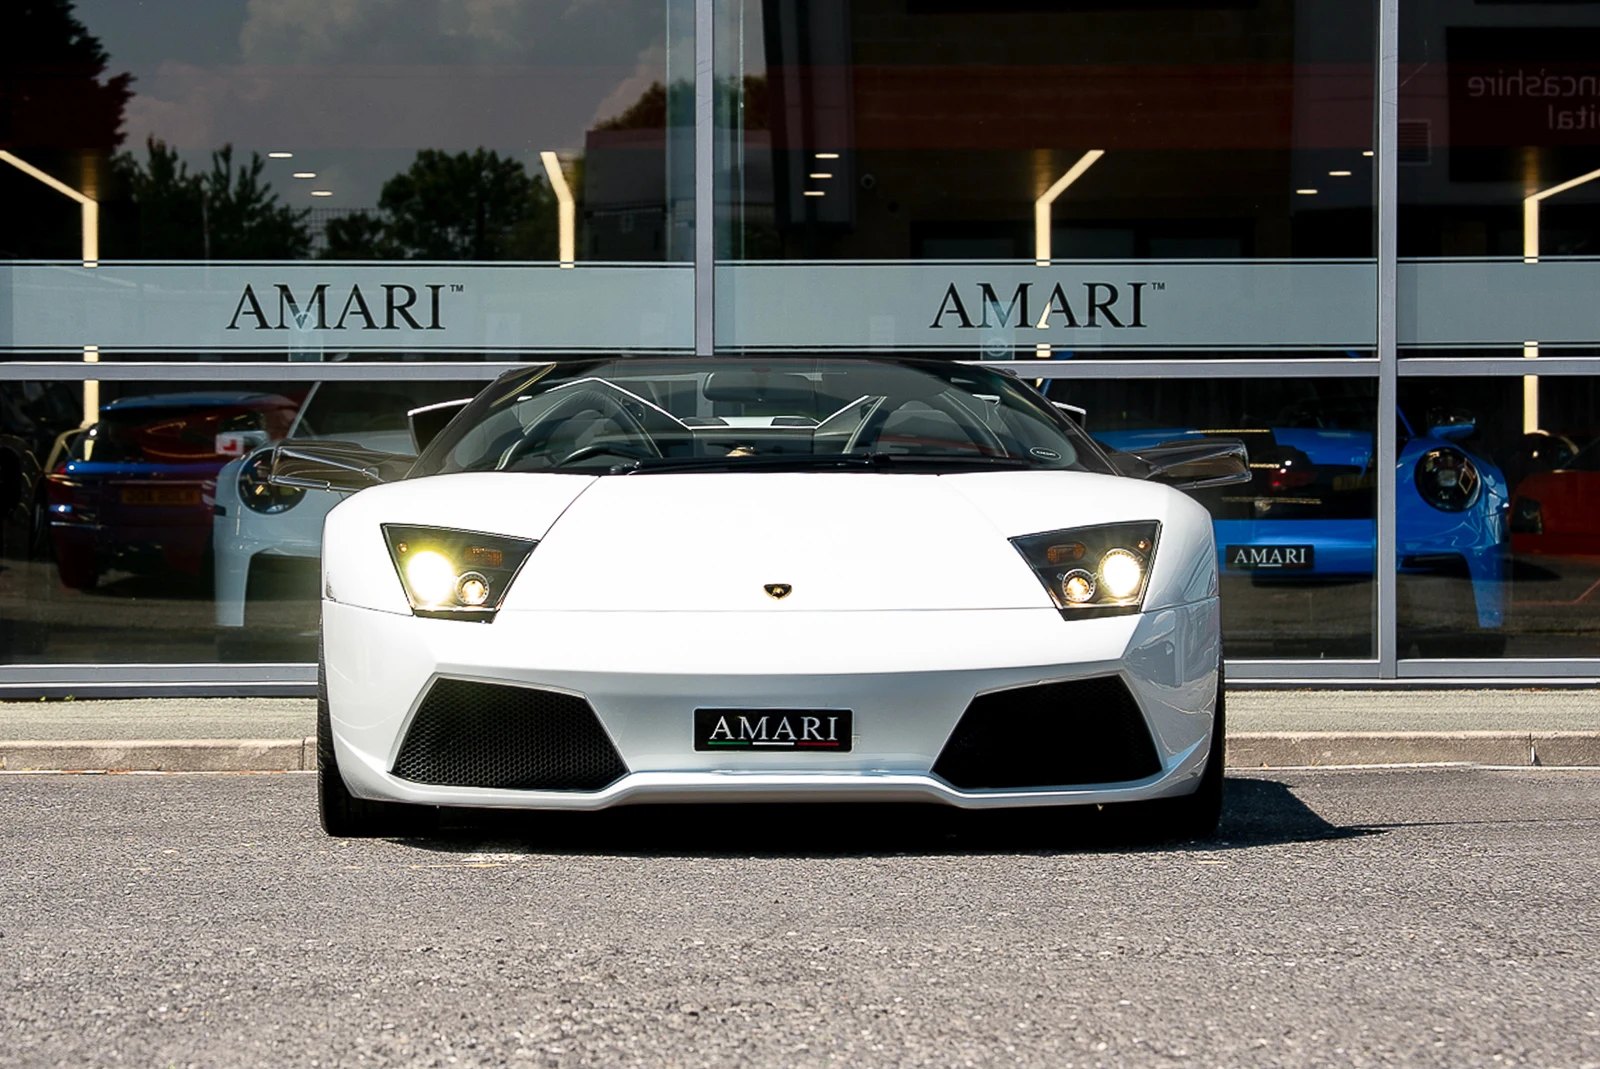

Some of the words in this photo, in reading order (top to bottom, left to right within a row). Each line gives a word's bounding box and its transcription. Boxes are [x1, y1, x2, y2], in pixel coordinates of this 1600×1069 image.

[225, 283, 446, 330] AMARI
[929, 282, 1148, 329] AMARI
[1233, 548, 1306, 564] AMARI
[709, 715, 839, 741] AMARI
